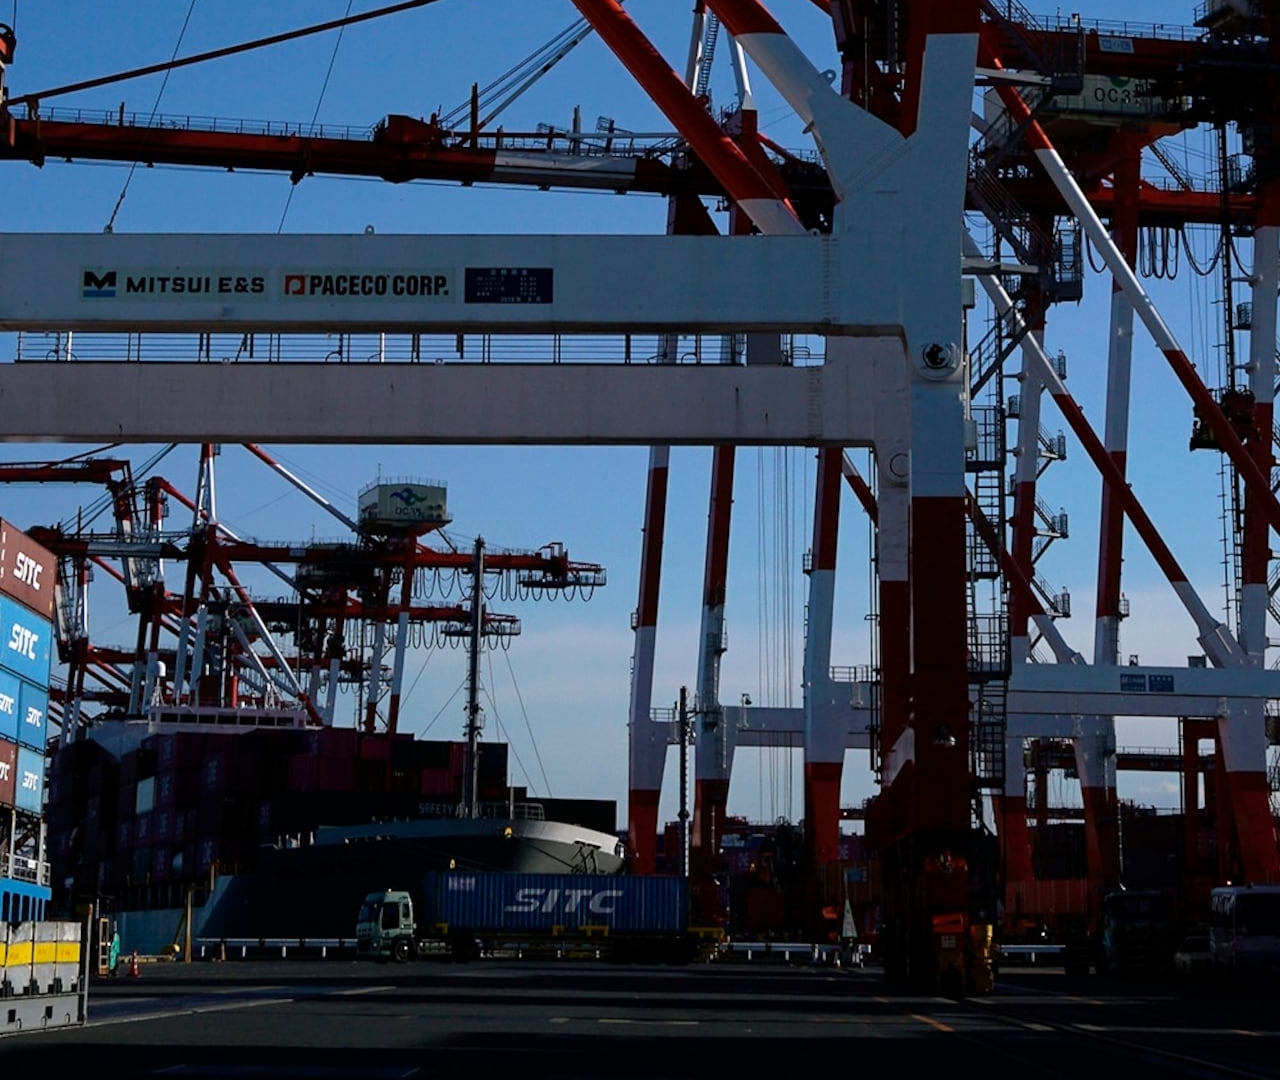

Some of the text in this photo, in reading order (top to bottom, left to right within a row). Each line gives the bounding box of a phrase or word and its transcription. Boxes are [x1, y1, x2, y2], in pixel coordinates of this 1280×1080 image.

[126, 277, 265, 293] MITSUI E&S
[309, 275, 387, 296] PACECO
[392, 275, 450, 296] CORP.
[12, 551, 44, 591] SITC
[8, 623, 40, 660] SITC
[418, 802, 453, 816] SAFETY
[504, 887, 625, 914] SITC
